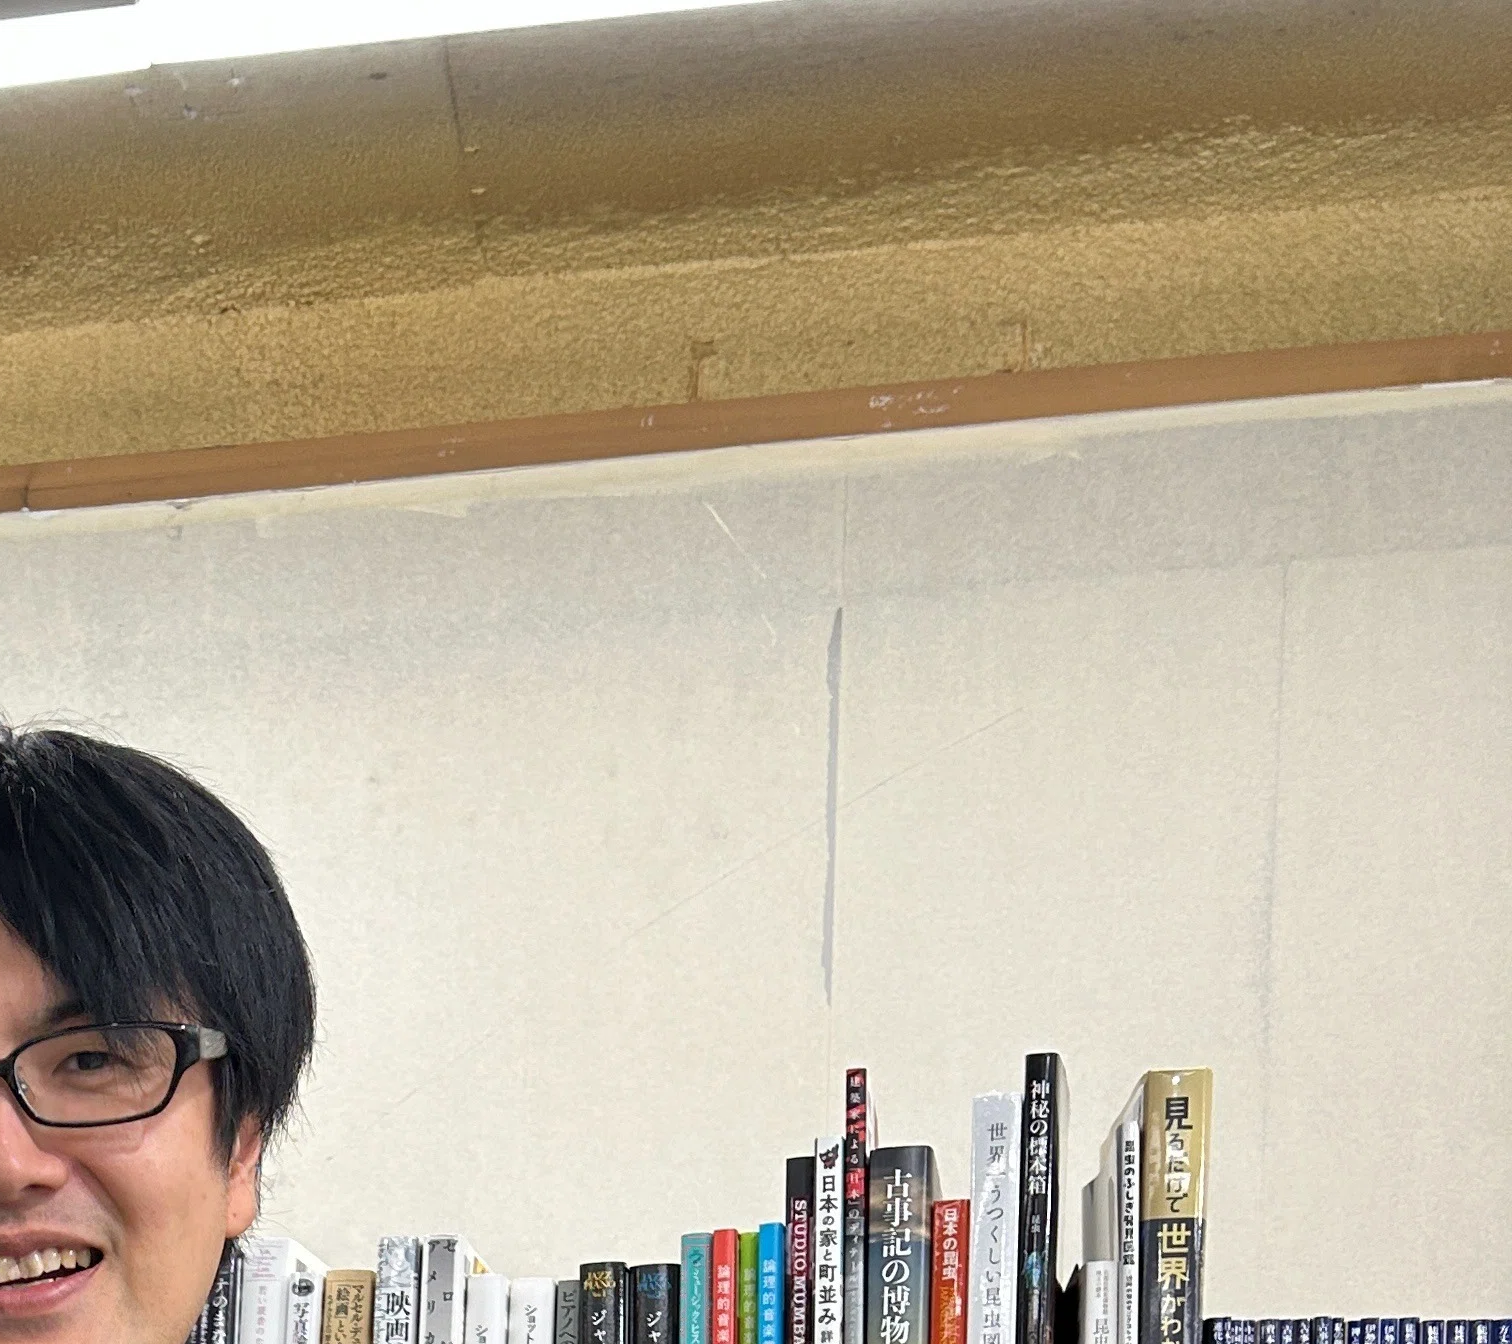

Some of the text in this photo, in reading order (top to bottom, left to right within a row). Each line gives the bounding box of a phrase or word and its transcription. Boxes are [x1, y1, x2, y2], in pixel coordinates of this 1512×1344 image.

[1028, 1078, 1051, 1195] 神秘の標本箱
[1164, 1095, 1193, 1214] 見るだけで
[793, 1199, 807, 1264] STUDIO
[817, 1174, 839, 1324] 日本の家と町並み
[941, 1207, 957, 1281] 日本の昆虫
